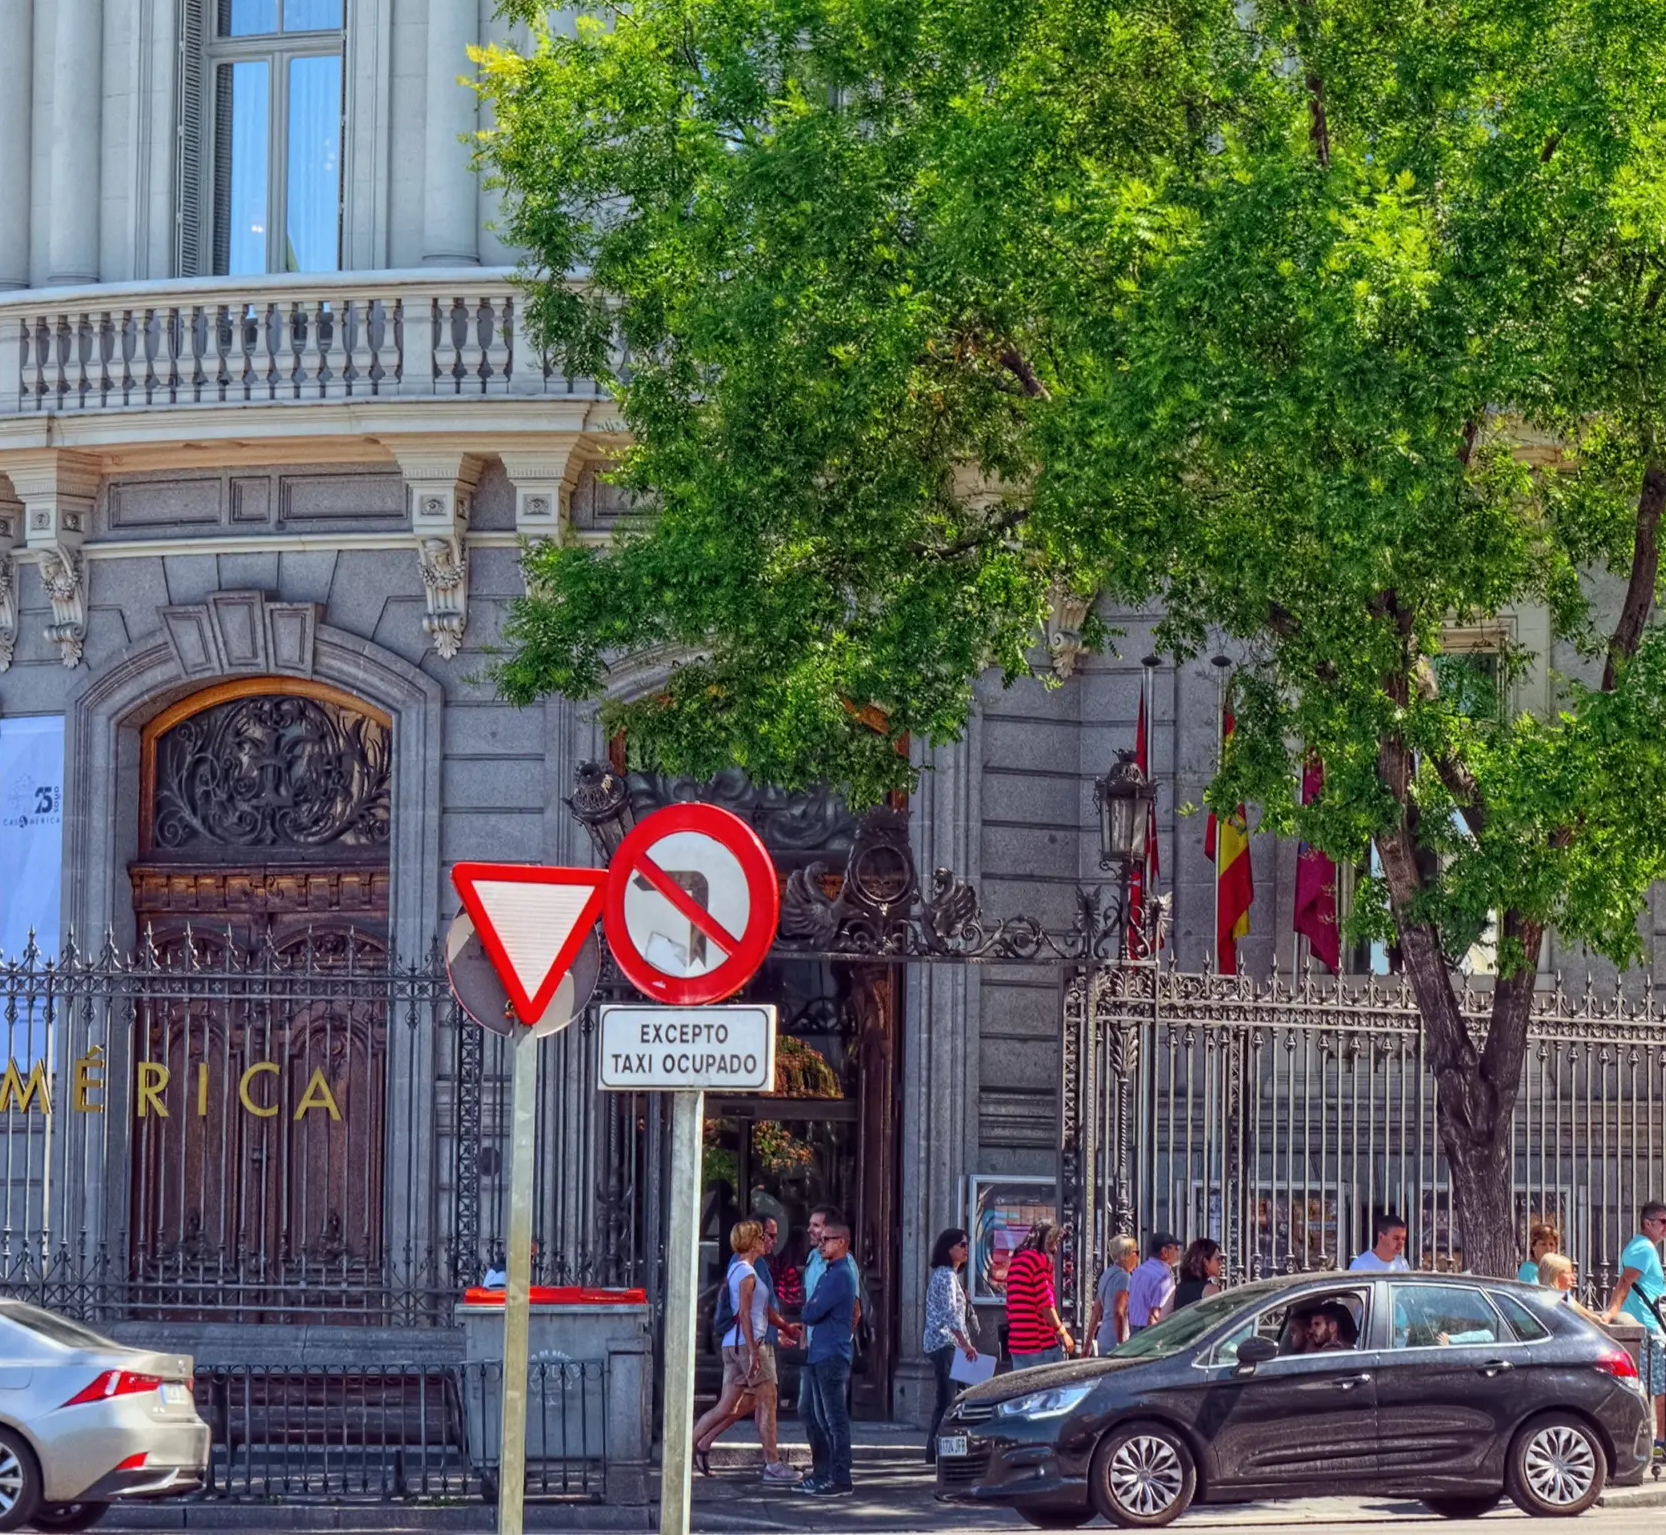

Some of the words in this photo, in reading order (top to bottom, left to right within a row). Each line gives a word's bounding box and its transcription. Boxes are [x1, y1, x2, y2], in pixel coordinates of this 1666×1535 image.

[35, 786, 53, 814] 25
[640, 1024, 728, 1044] EXCEPTO
[612, 1054, 652, 1074] TAXI
[662, 1054, 757, 1074] OCUPADO
